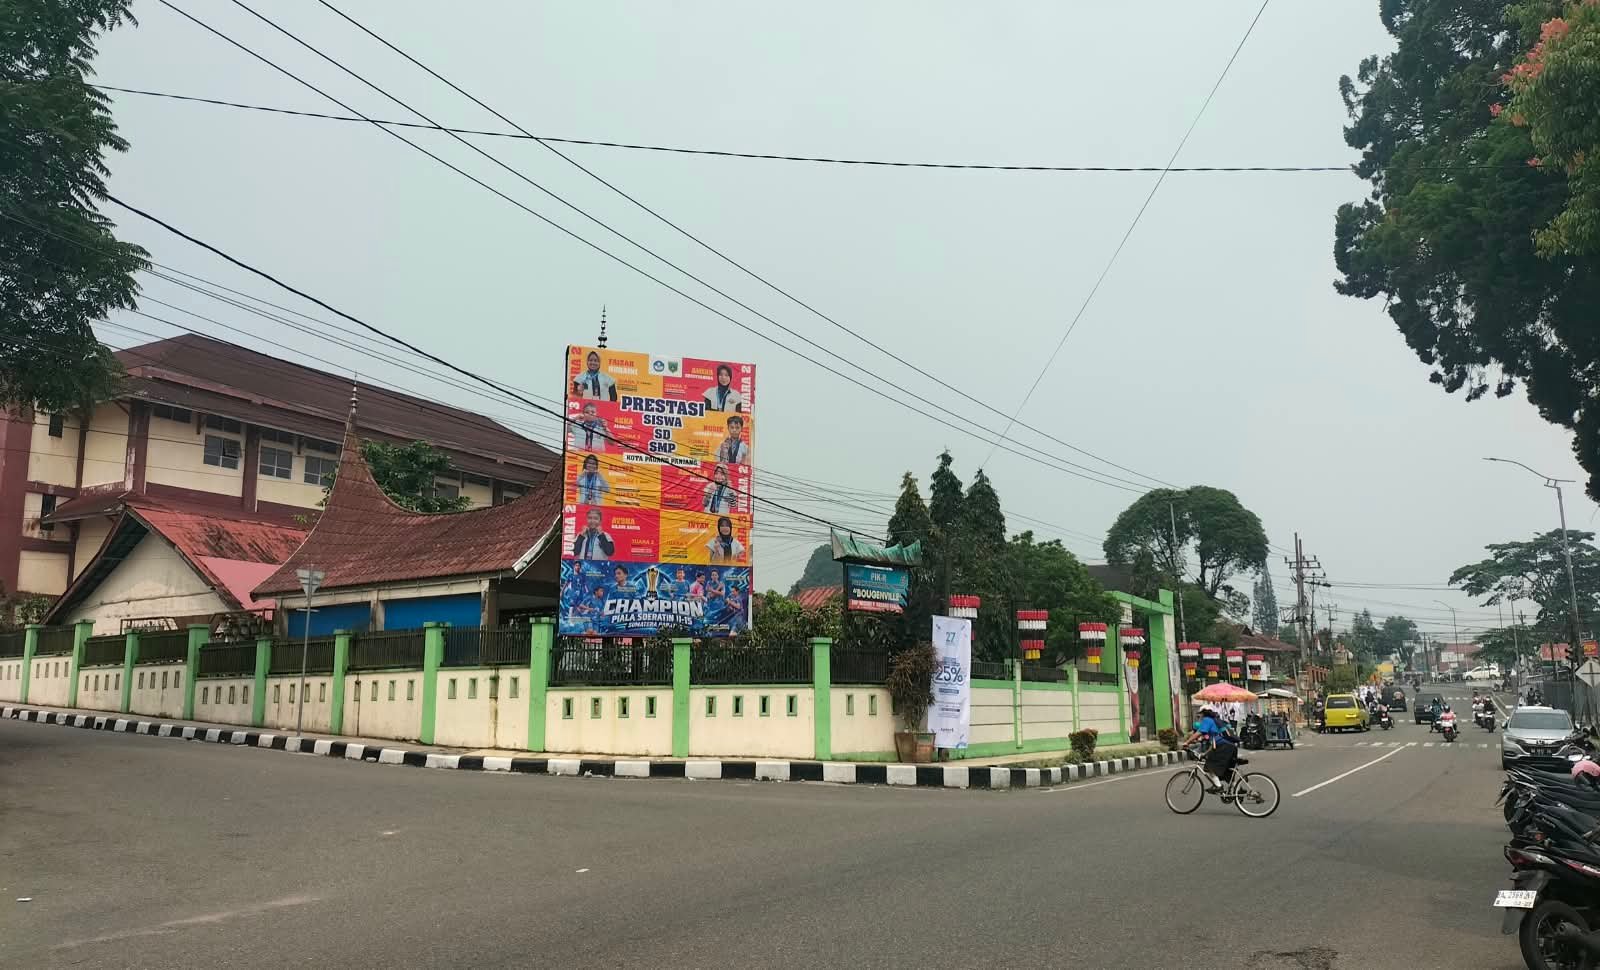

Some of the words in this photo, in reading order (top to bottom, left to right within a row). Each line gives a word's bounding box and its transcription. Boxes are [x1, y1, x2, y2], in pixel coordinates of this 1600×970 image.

[621, 395, 704, 417] PRESTASI
[643, 414, 682, 427] SISWA
[654, 428, 671, 440] SD
[649, 441, 676, 453] SMP
[626, 454, 643, 462] KOTA
[565, 504, 577, 513] 2
[563, 516, 576, 556] JUARA
[603, 599, 705, 617] CHAMPION
[611, 613, 636, 624] PIALA
[945, 631, 956, 643] 27
[935, 664, 964, 683] 25%
